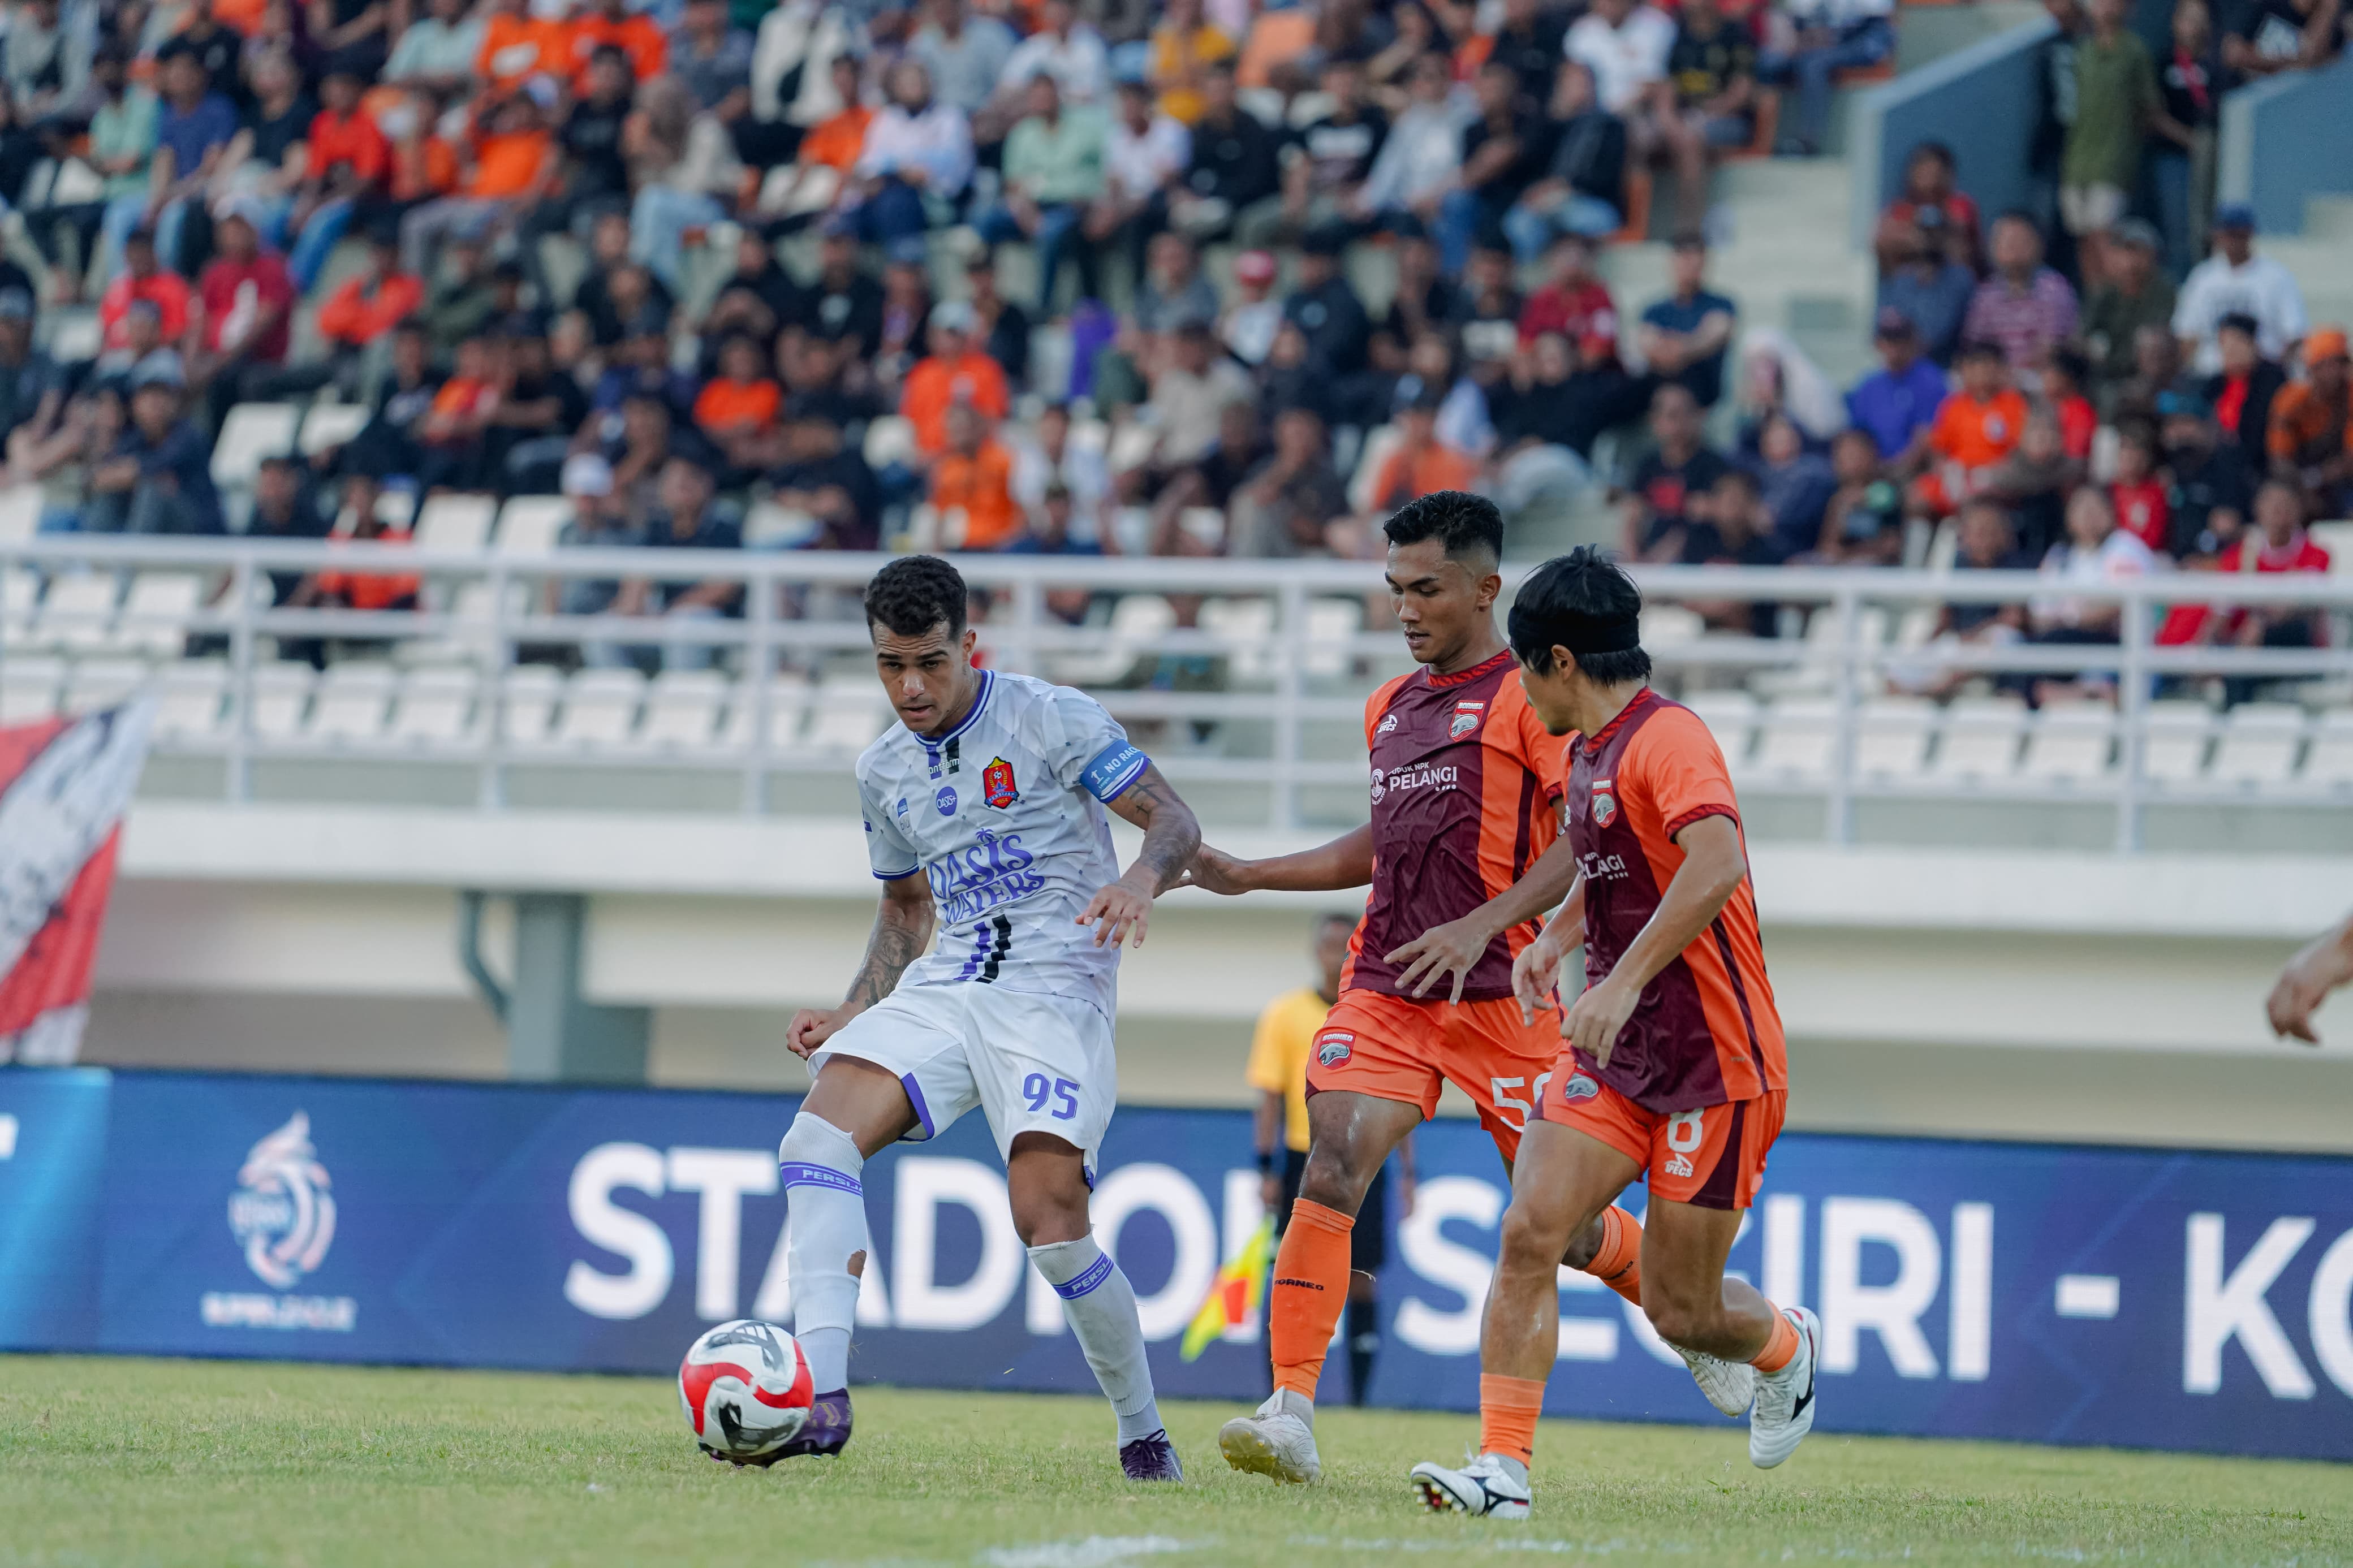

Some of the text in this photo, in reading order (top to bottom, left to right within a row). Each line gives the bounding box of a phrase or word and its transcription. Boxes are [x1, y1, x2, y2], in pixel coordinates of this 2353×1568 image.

[1104, 758, 1121, 774] NO
[1414, 762, 1430, 770] NPK
[1389, 767, 1457, 792] PELANGI
[929, 835, 1033, 900] OASIS
[942, 868, 1045, 925] WATERS
[1023, 1073, 1080, 1120] 95
[1665, 1163, 1693, 1178] SPECS
